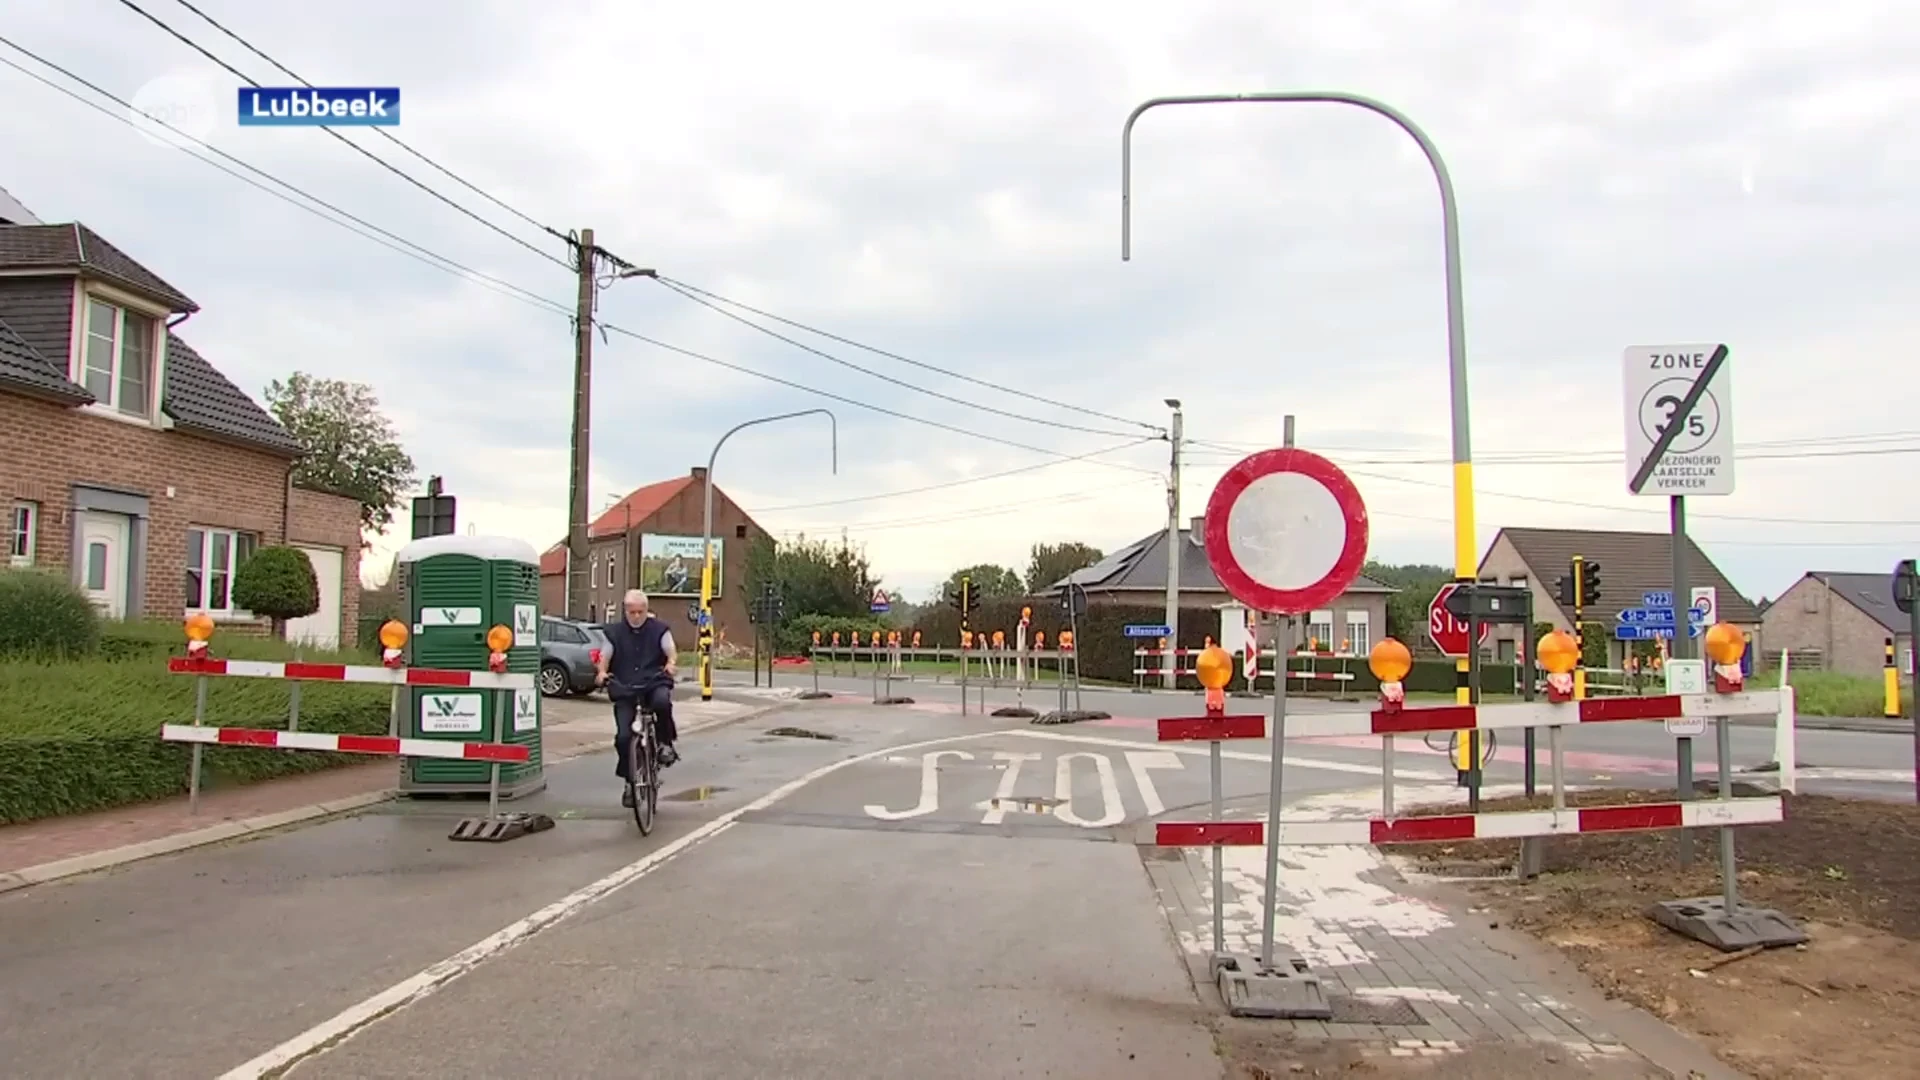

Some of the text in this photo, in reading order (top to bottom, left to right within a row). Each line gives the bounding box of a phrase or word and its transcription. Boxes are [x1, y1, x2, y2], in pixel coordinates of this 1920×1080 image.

[1650, 353, 1705, 369] ZONE
[1651, 467, 1717, 477] LAATSELIJK
[1657, 478, 1706, 488] VERKEER
[1636, 627, 1673, 638] Tienen
